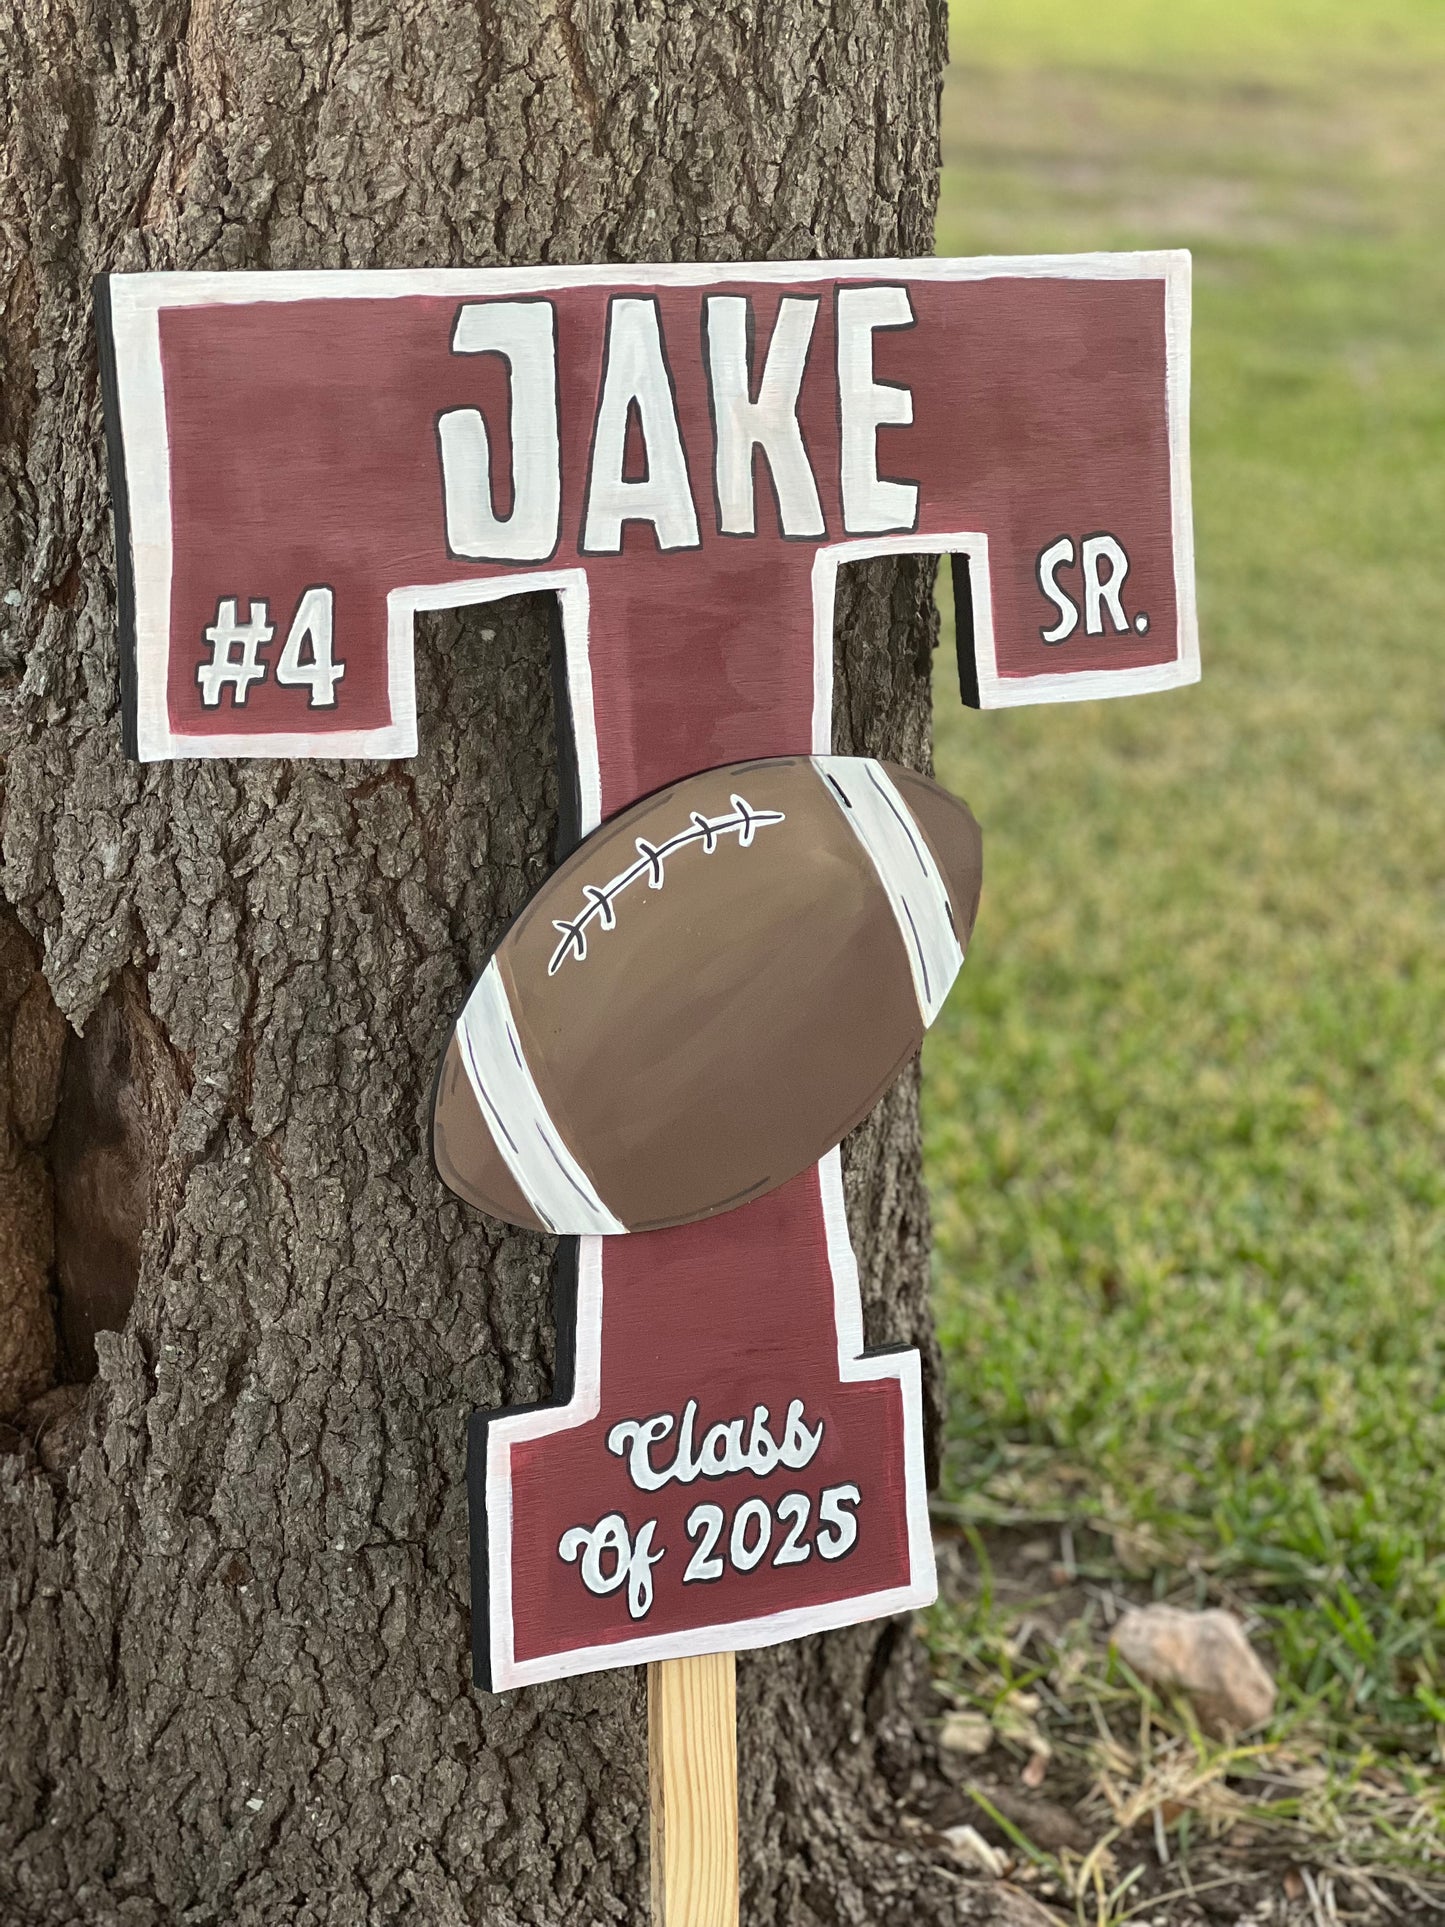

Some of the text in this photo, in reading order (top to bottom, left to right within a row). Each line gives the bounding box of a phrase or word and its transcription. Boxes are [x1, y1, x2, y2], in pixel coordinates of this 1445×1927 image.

[436, 284, 920, 563] JAKE
[196, 585, 346, 707] #4
[1038, 534, 1149, 643] SR.
[606, 1398, 824, 1492] Class
[557, 1483, 862, 1619] Of 2025
